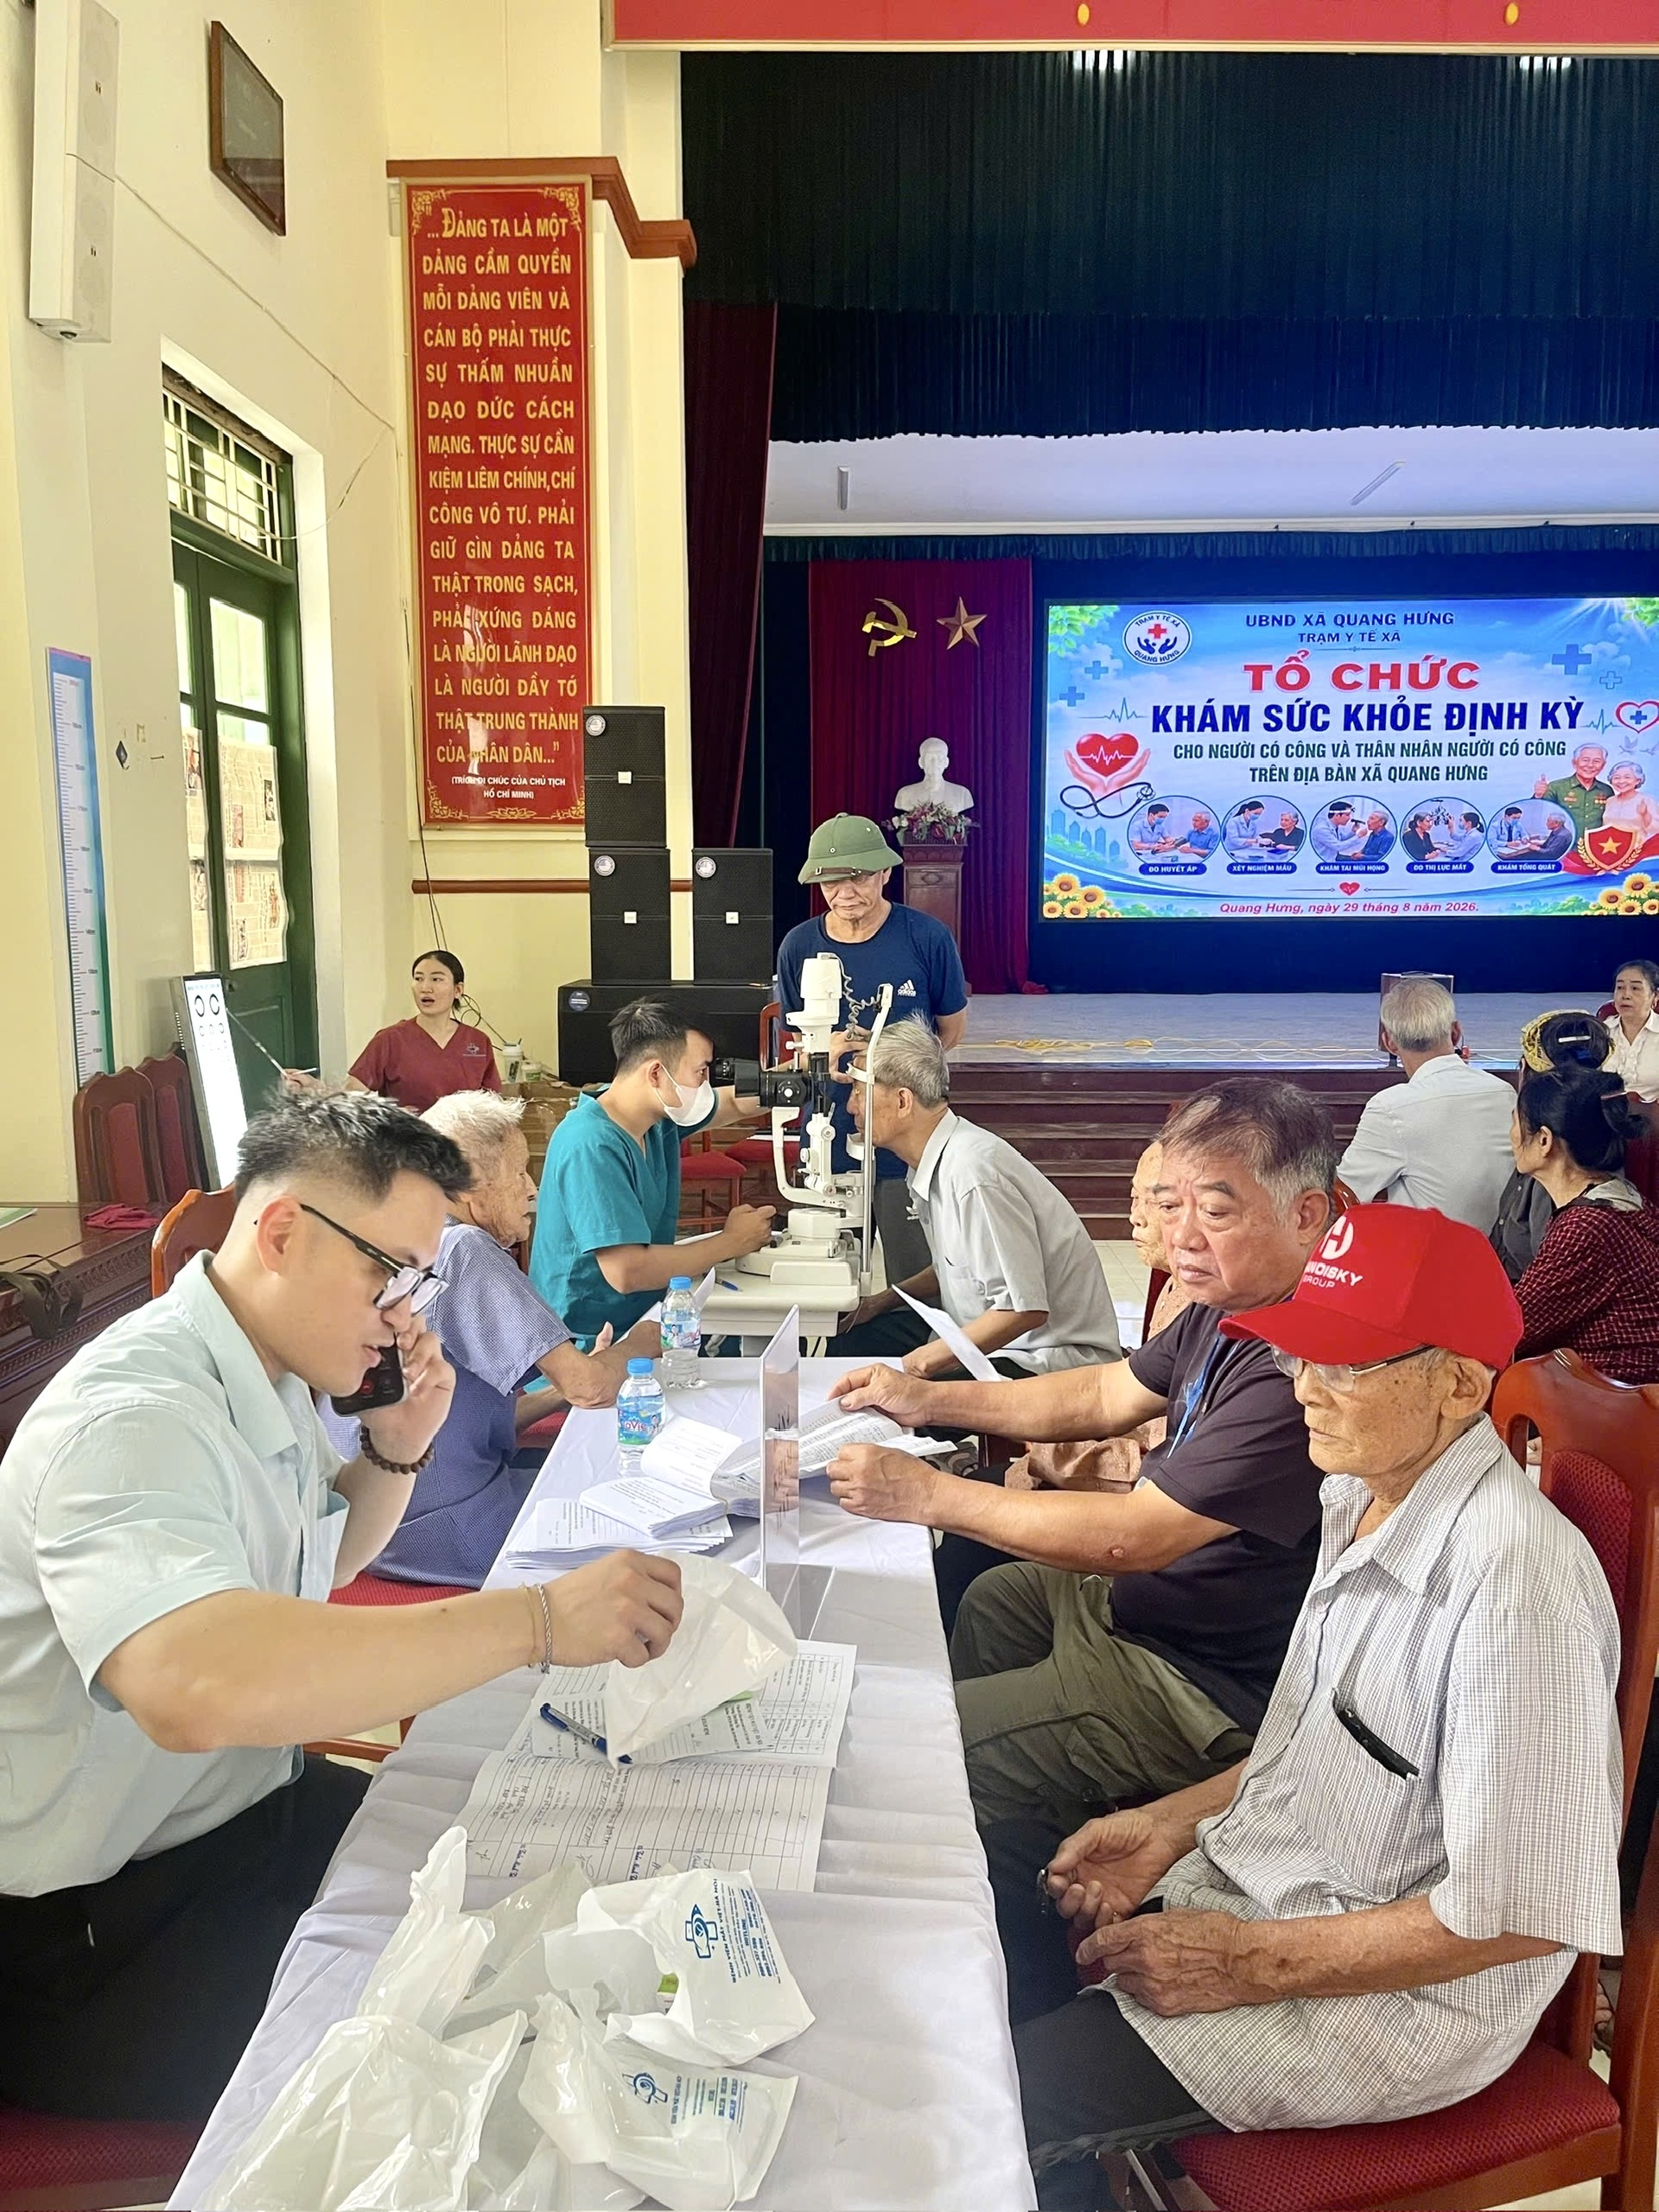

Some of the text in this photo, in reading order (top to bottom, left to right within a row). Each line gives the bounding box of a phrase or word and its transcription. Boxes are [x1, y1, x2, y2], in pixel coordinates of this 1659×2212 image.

[490, 218, 510, 238] TA
[513, 212, 531, 238] LÀ
[536, 212, 569, 243] MỘT
[474, 246, 510, 275] CẦM
[518, 246, 571, 275] QUYỀN
[423, 283, 452, 310] MỖI
[506, 286, 543, 310] VIÊN
[548, 285, 570, 310] VÀ
[423, 319, 571, 353] CÁN BỘ PHẢI THỰC
[425, 356, 573, 389] SỰ THẤM NHUẦN
[427, 395, 575, 423] ĐẠO ĐỨC CÁCH
[428, 429, 575, 460] MẠNG. THỰC SỰ CẦN
[429, 466, 463, 495] KIỆM
[467, 465, 499, 489] LIÊM
[429, 498, 575, 524] CÔNG VÔ TƯ. PHẢI
[429, 532, 575, 560] GIỮ GÌN ĐẢNG TA
[432, 570, 578, 598] THẬT TRONG SẠCH,
[479, 607, 522, 628] XỨNG
[531, 607, 576, 628] ĐÁNG
[1246, 611, 1454, 627] UBND XÃ QUANG HƯNG
[1298, 629, 1401, 645] TRẠM Y TẾ XÃ
[434, 639, 577, 667] LÀ NGƯỜI LÃNH ĐẠO
[1134, 649, 1180, 663] QUANG HƯNG
[1243, 650, 1481, 692] TỔ CHỨC
[435, 672, 578, 697] LÀ NGƯỜI ĐẦY TỚ
[435, 709, 474, 734] THẬT
[476, 712, 527, 731] TRUNG
[530, 708, 579, 731] THÀNH
[1152, 696, 1584, 737] KHÁM SỨC KHỎE ĐỊNH KỲ
[436, 741, 466, 764] CỦA
[1173, 739, 1566, 760] CHO NGƯỜI CÓ CÔNG VÀ THÂN NHÂN NGƯỜI CÓ CÔNG
[487, 775, 510, 786] CHÚC
[511, 776, 529, 786] CỦA
[531, 776, 546, 786] CHỦ
[548, 778, 566, 787] TỊCH
[1249, 763, 1488, 785] TRÊN ĐỊA BÀN XÃ QUANG HƯNG
[483, 787, 495, 798] HỒ
[497, 789, 510, 799] CHÍ
[1160, 864, 1185, 873] HUYẾT
[1186, 864, 1198, 873] ÁP
[1232, 863, 1292, 873] XÉT NGHIỆM MÁU
[1319, 863, 1338, 872] KHÁM
[1352, 863, 1366, 872] MŨI
[1368, 864, 1386, 873] HỌNG
[1425, 863, 1436, 873] THỊ
[1437, 863, 1450, 873] LỰC
[1497, 862, 1555, 872] KHÁM TỔNG QUÁT
[1220, 901, 1478, 915] Quang Hưng, ngày 29 tháng 8 năm 2026.
[741, 1919, 750, 1946] HOTLINE
